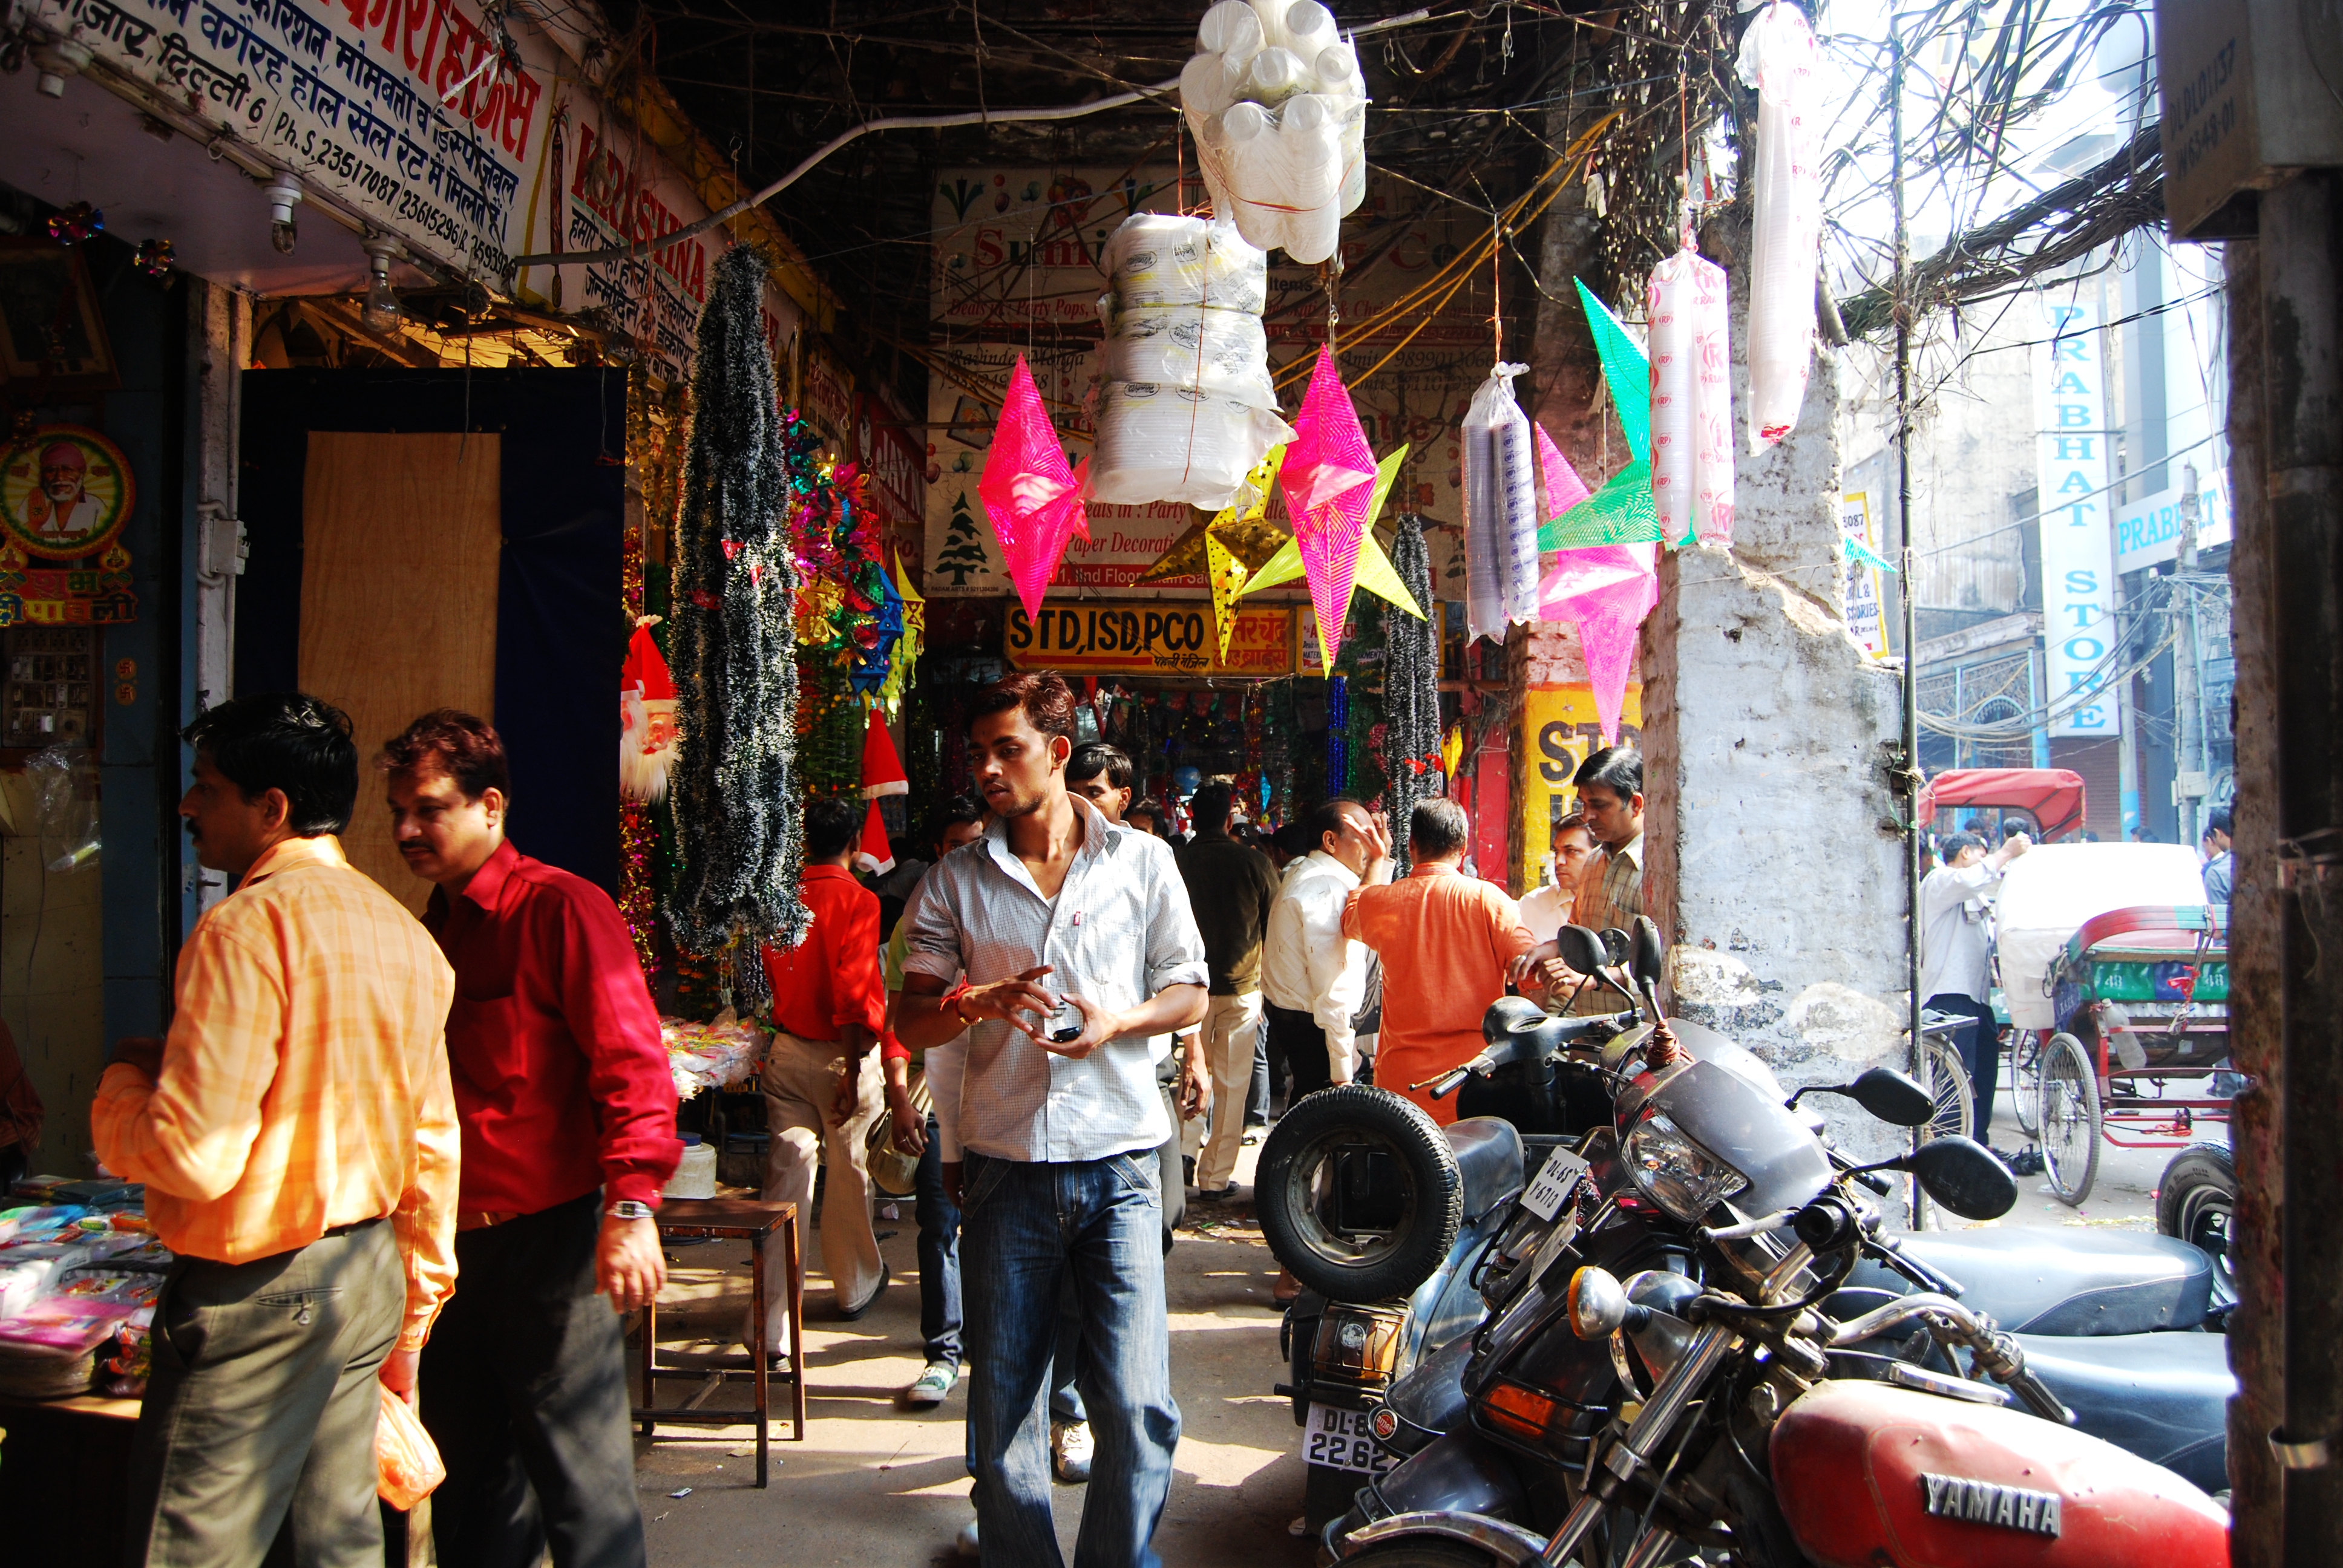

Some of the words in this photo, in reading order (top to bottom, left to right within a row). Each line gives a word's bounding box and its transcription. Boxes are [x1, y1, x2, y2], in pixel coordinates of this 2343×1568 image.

[975, 227, 1106, 268] Sumi
[2049, 305, 2097, 527] PRABHAT
[1085, 501, 1116, 519] eals
[2117, 490, 2218, 555] PRABT
[2063, 569, 2107, 729] STORE
[2105, 975, 2123, 988] 48
[1309, 1432, 1389, 1471] 2262
[1921, 1472, 2061, 1538] YAMAHA
